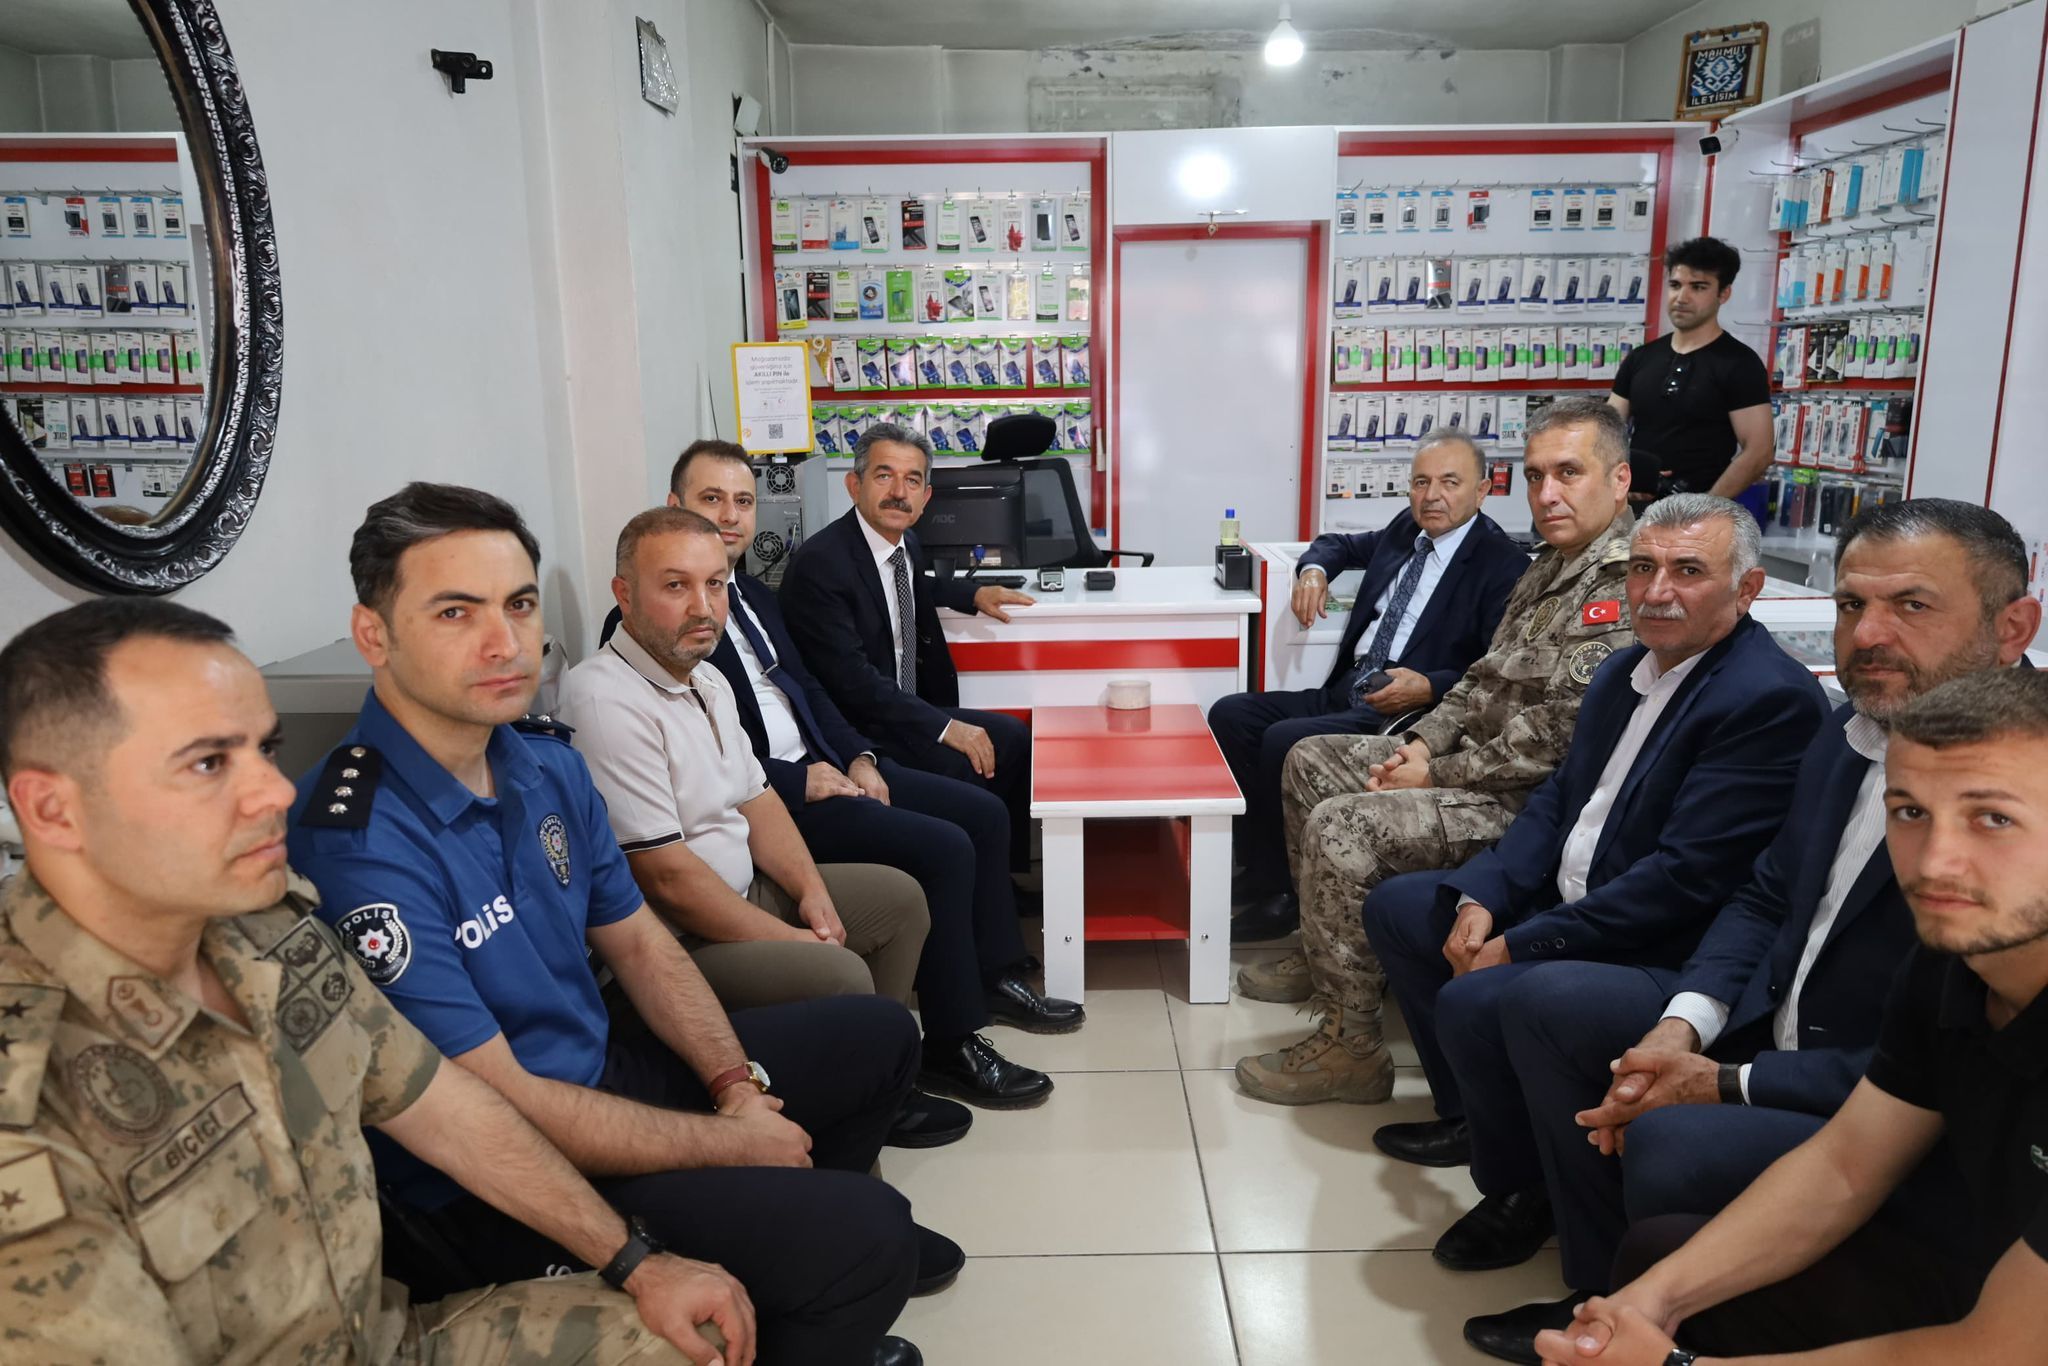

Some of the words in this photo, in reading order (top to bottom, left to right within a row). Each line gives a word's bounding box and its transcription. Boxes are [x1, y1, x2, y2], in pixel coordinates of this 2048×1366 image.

[1698, 45, 1746, 58] MAHMUT
[931, 514, 956, 524] AOC
[343, 907, 391, 931] POLİS
